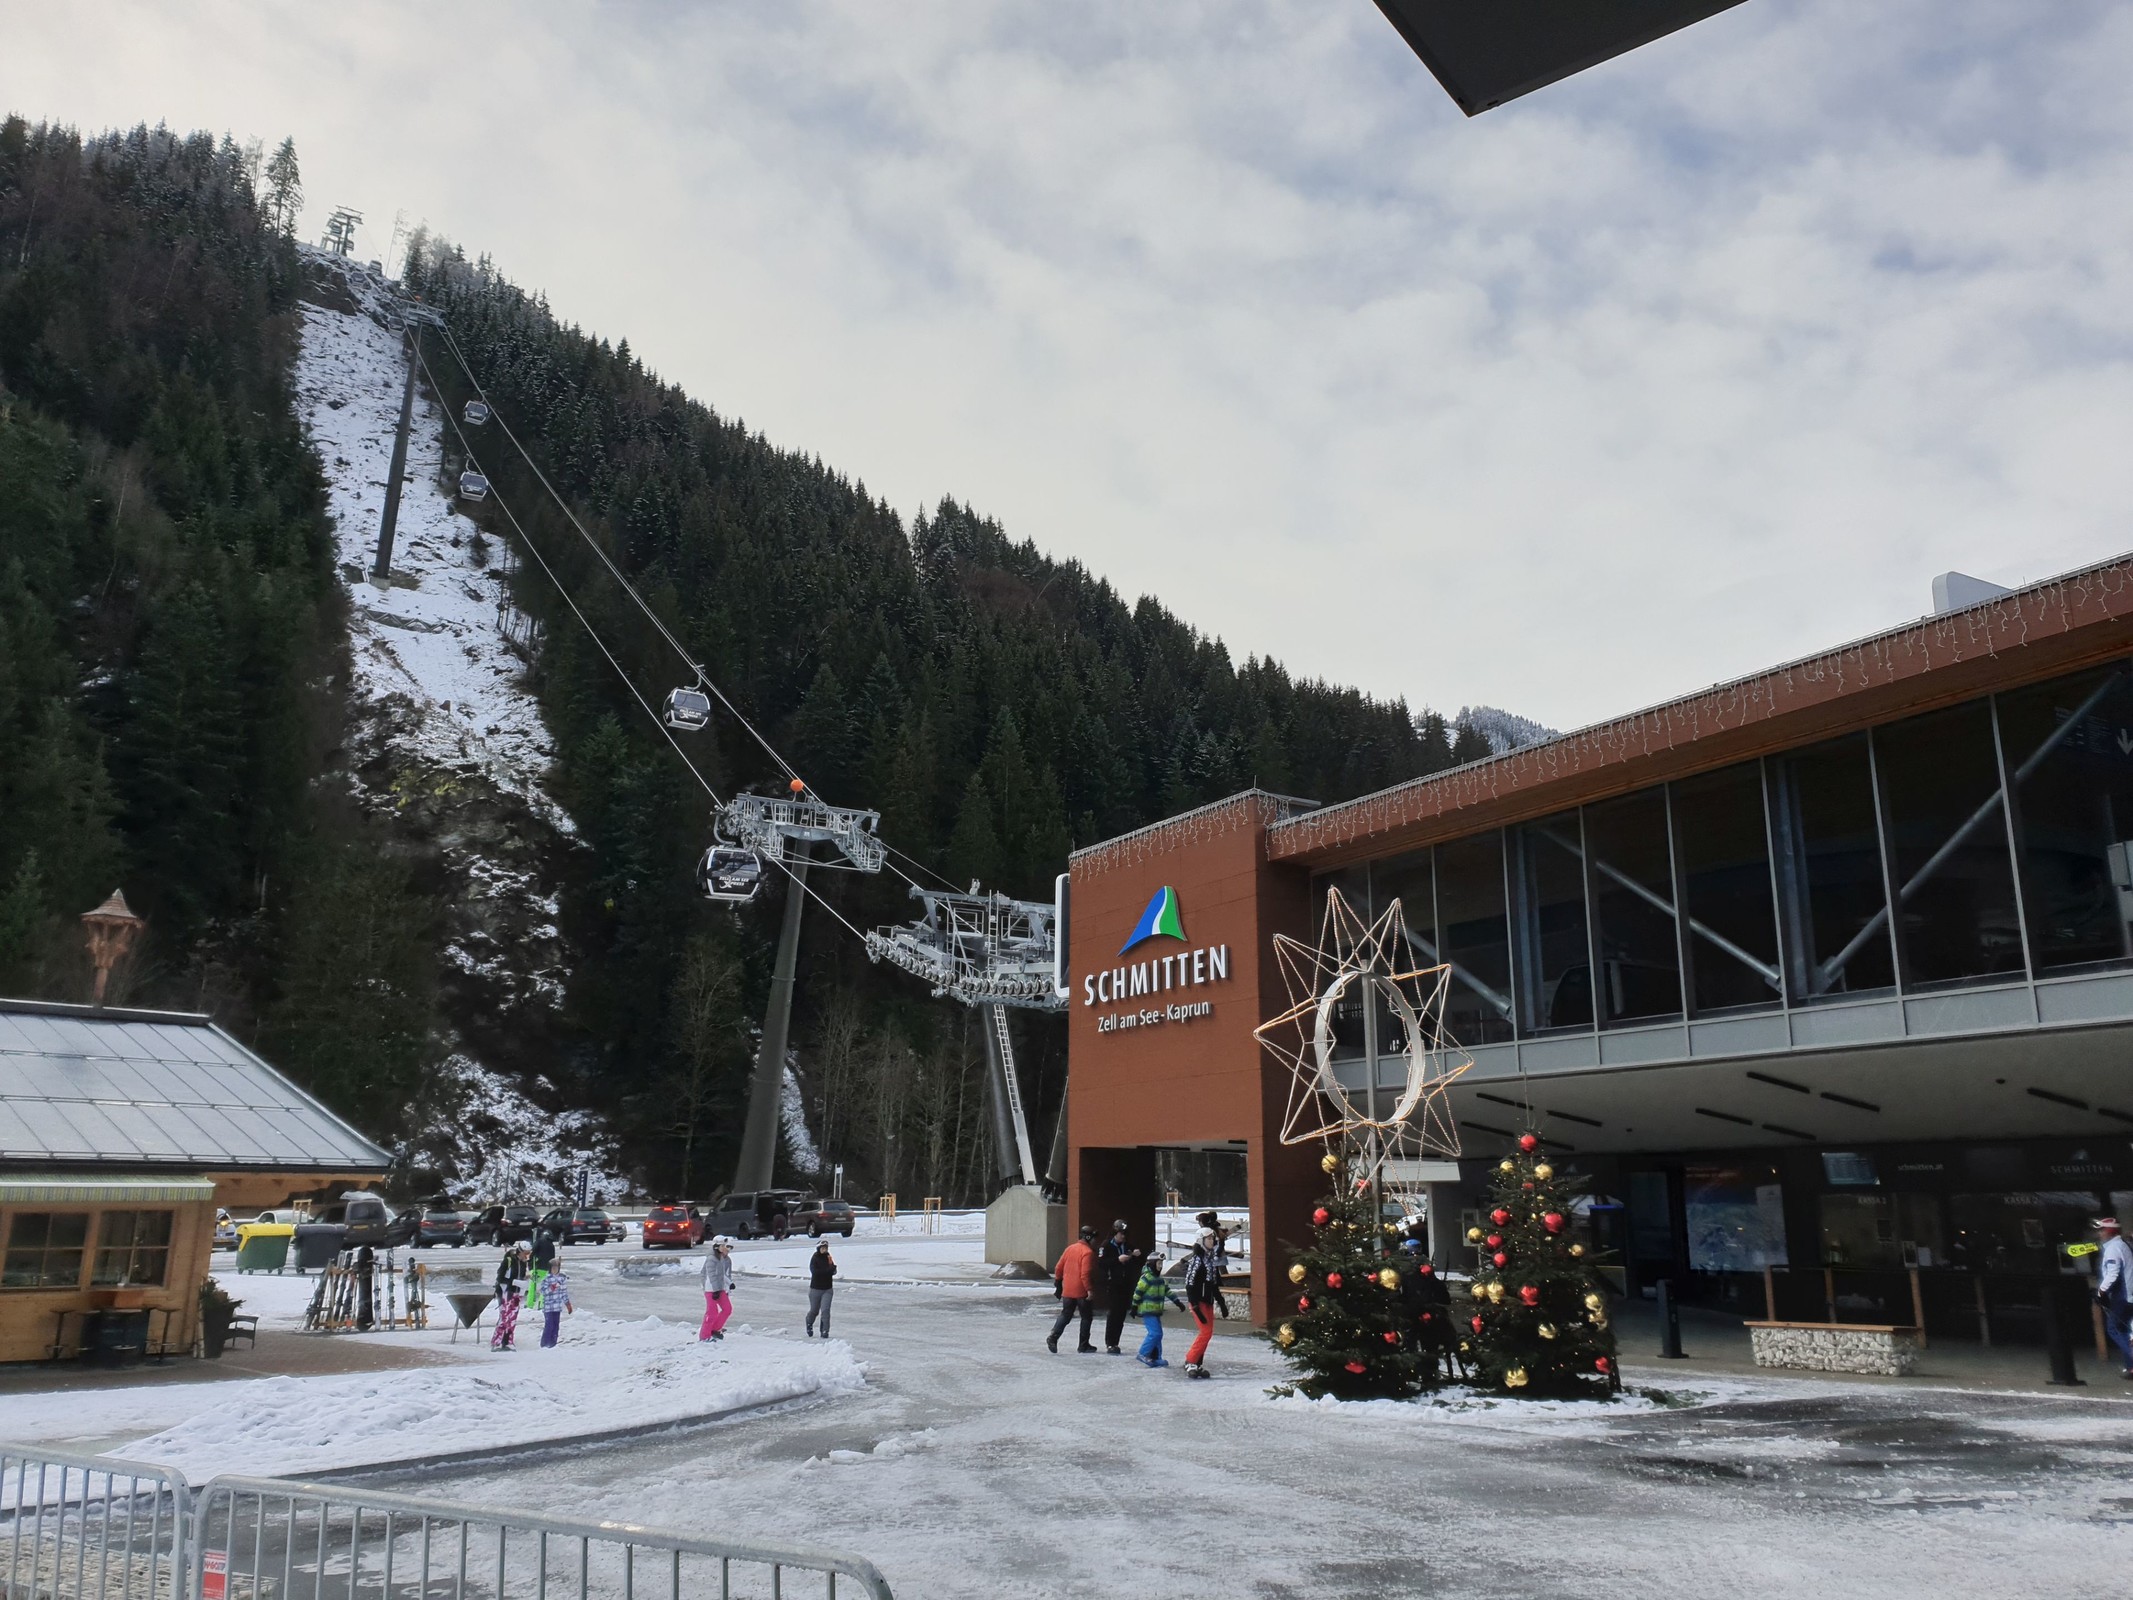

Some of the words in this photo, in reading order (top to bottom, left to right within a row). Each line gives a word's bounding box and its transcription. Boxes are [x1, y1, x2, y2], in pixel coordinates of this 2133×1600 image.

[1084, 944, 1228, 1006] SCHMITTEN
[1098, 1013, 1117, 1033] Zell
[1120, 1014, 1136, 1029] am
[2050, 1165, 2114, 1175] SCHMITTEN
[2003, 1196, 2031, 1205] KASSA
